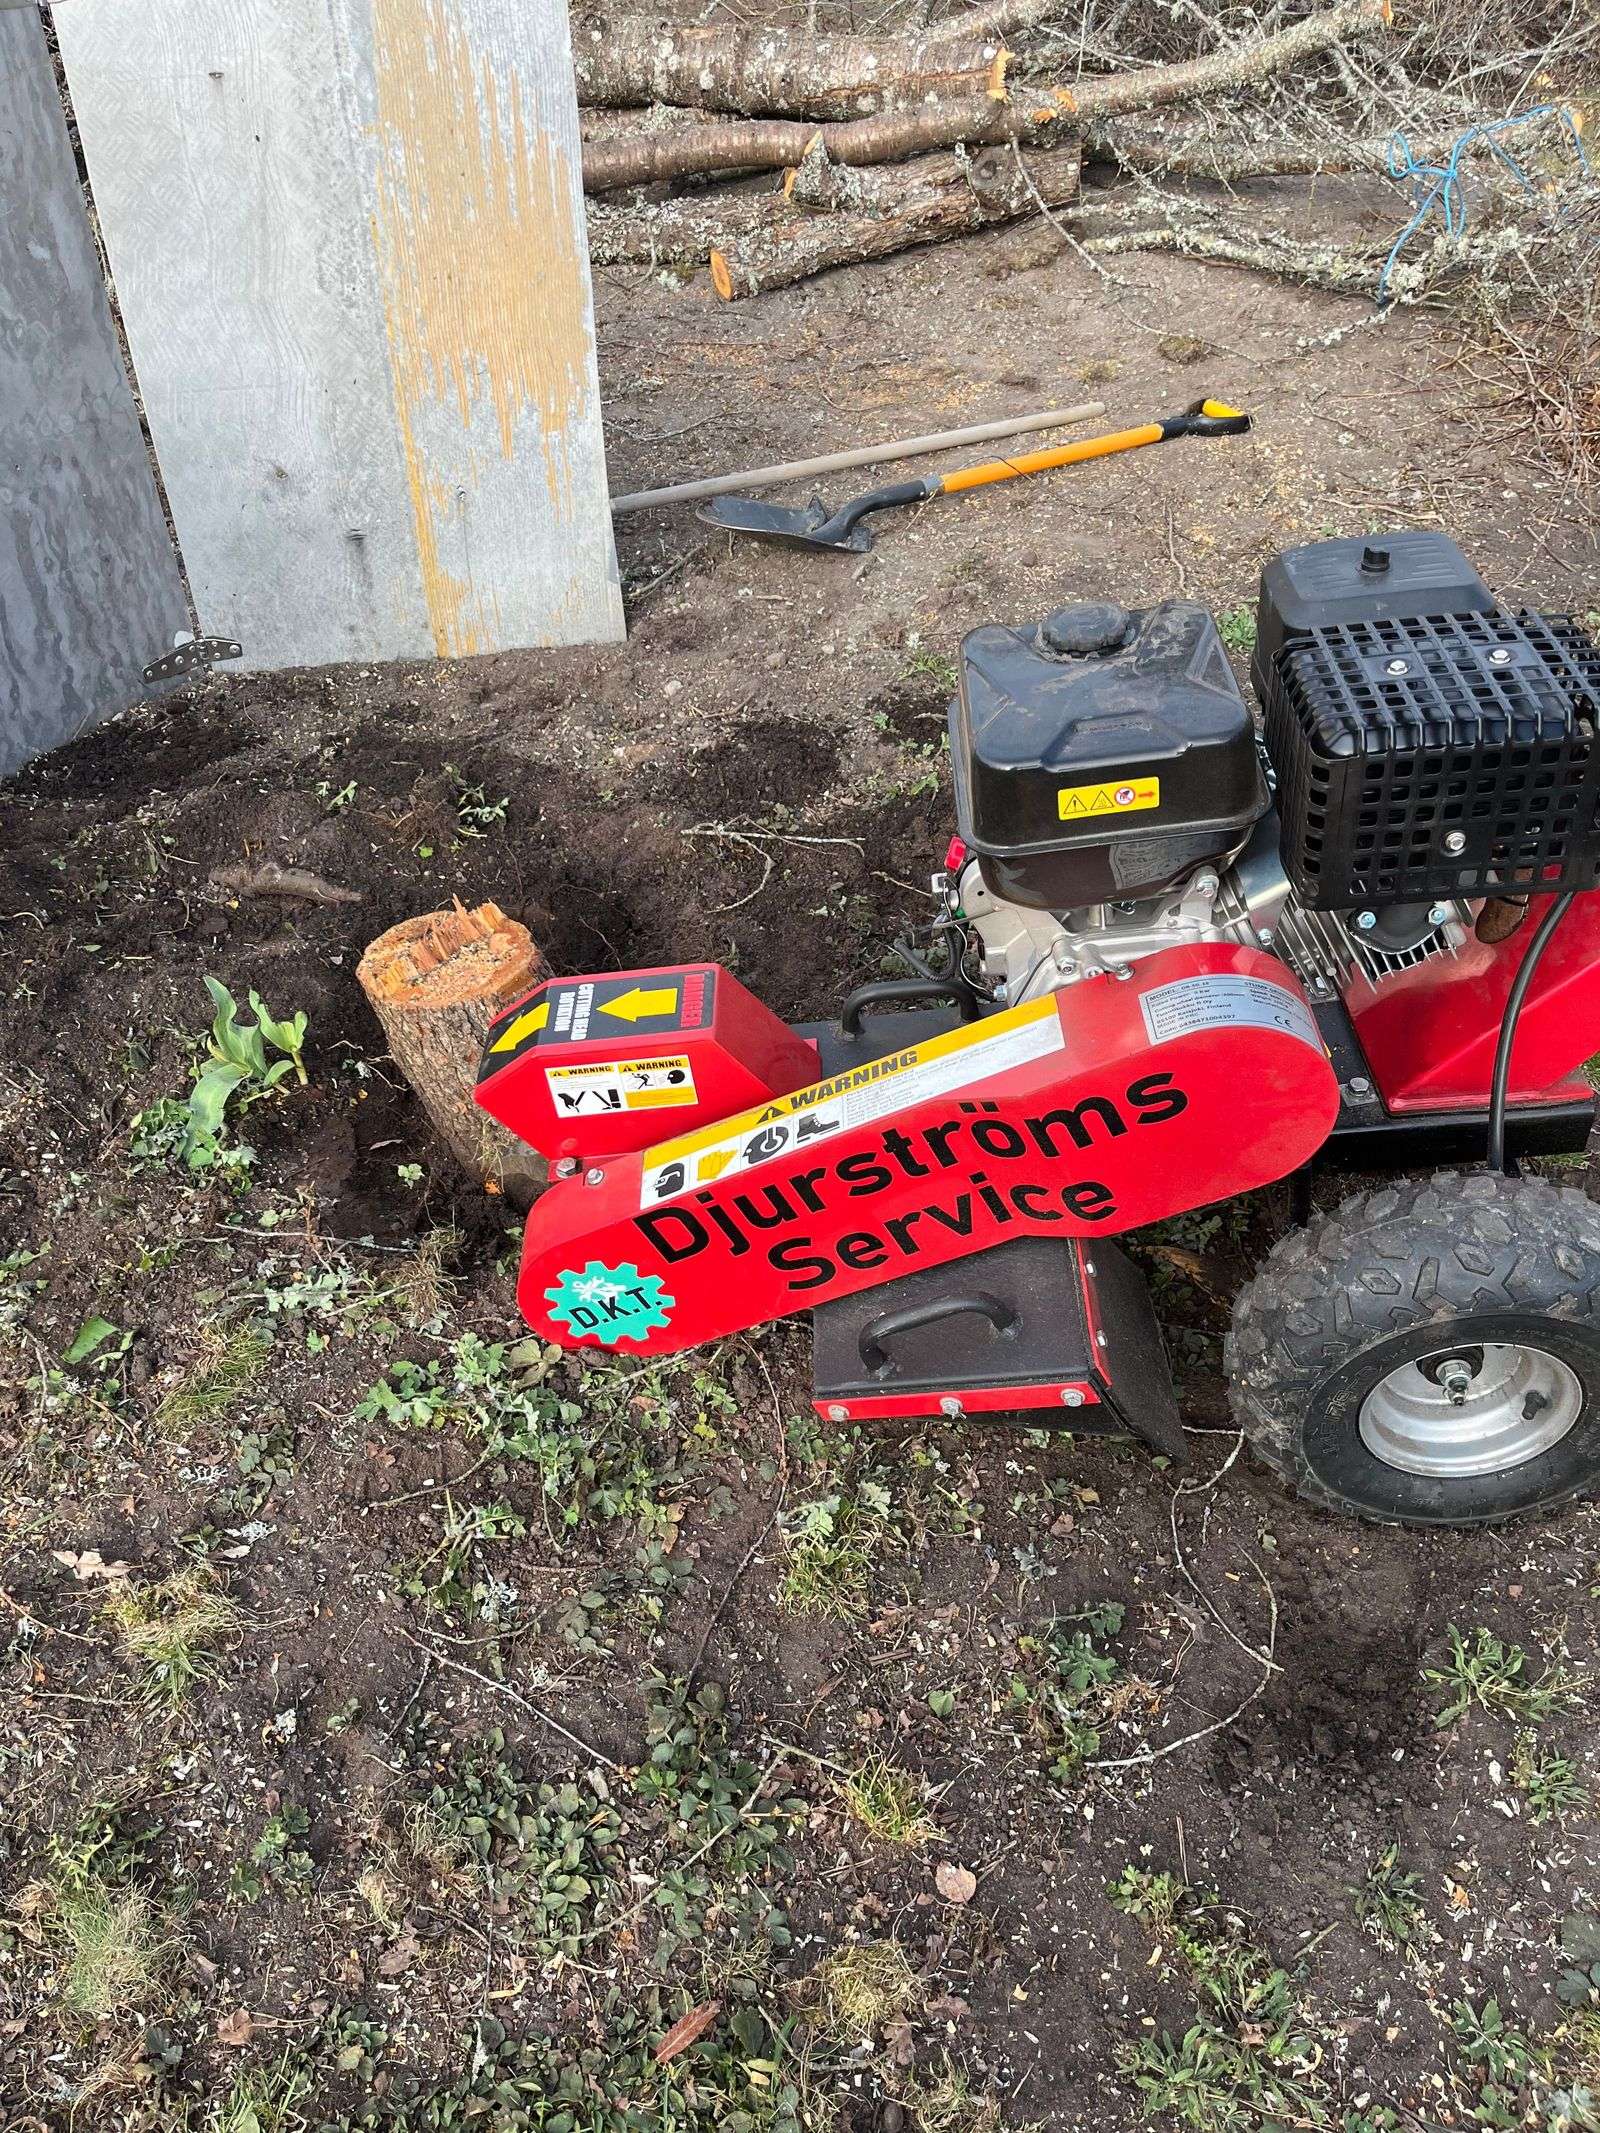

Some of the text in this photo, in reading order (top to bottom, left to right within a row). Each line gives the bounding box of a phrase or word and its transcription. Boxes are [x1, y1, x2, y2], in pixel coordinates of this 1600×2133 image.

[554, 991, 576, 1032] ROTATION
[570, 983, 595, 1041] CUTTING HEAD
[568, 1065, 612, 1076] WARNING
[635, 1059, 682, 1071] WARNING
[790, 1050, 917, 1110] WARNING
[633, 1071, 1190, 1264] Djurströms
[767, 1171, 1115, 1291] Service
[569, 1286, 663, 1329] D.K.T.
